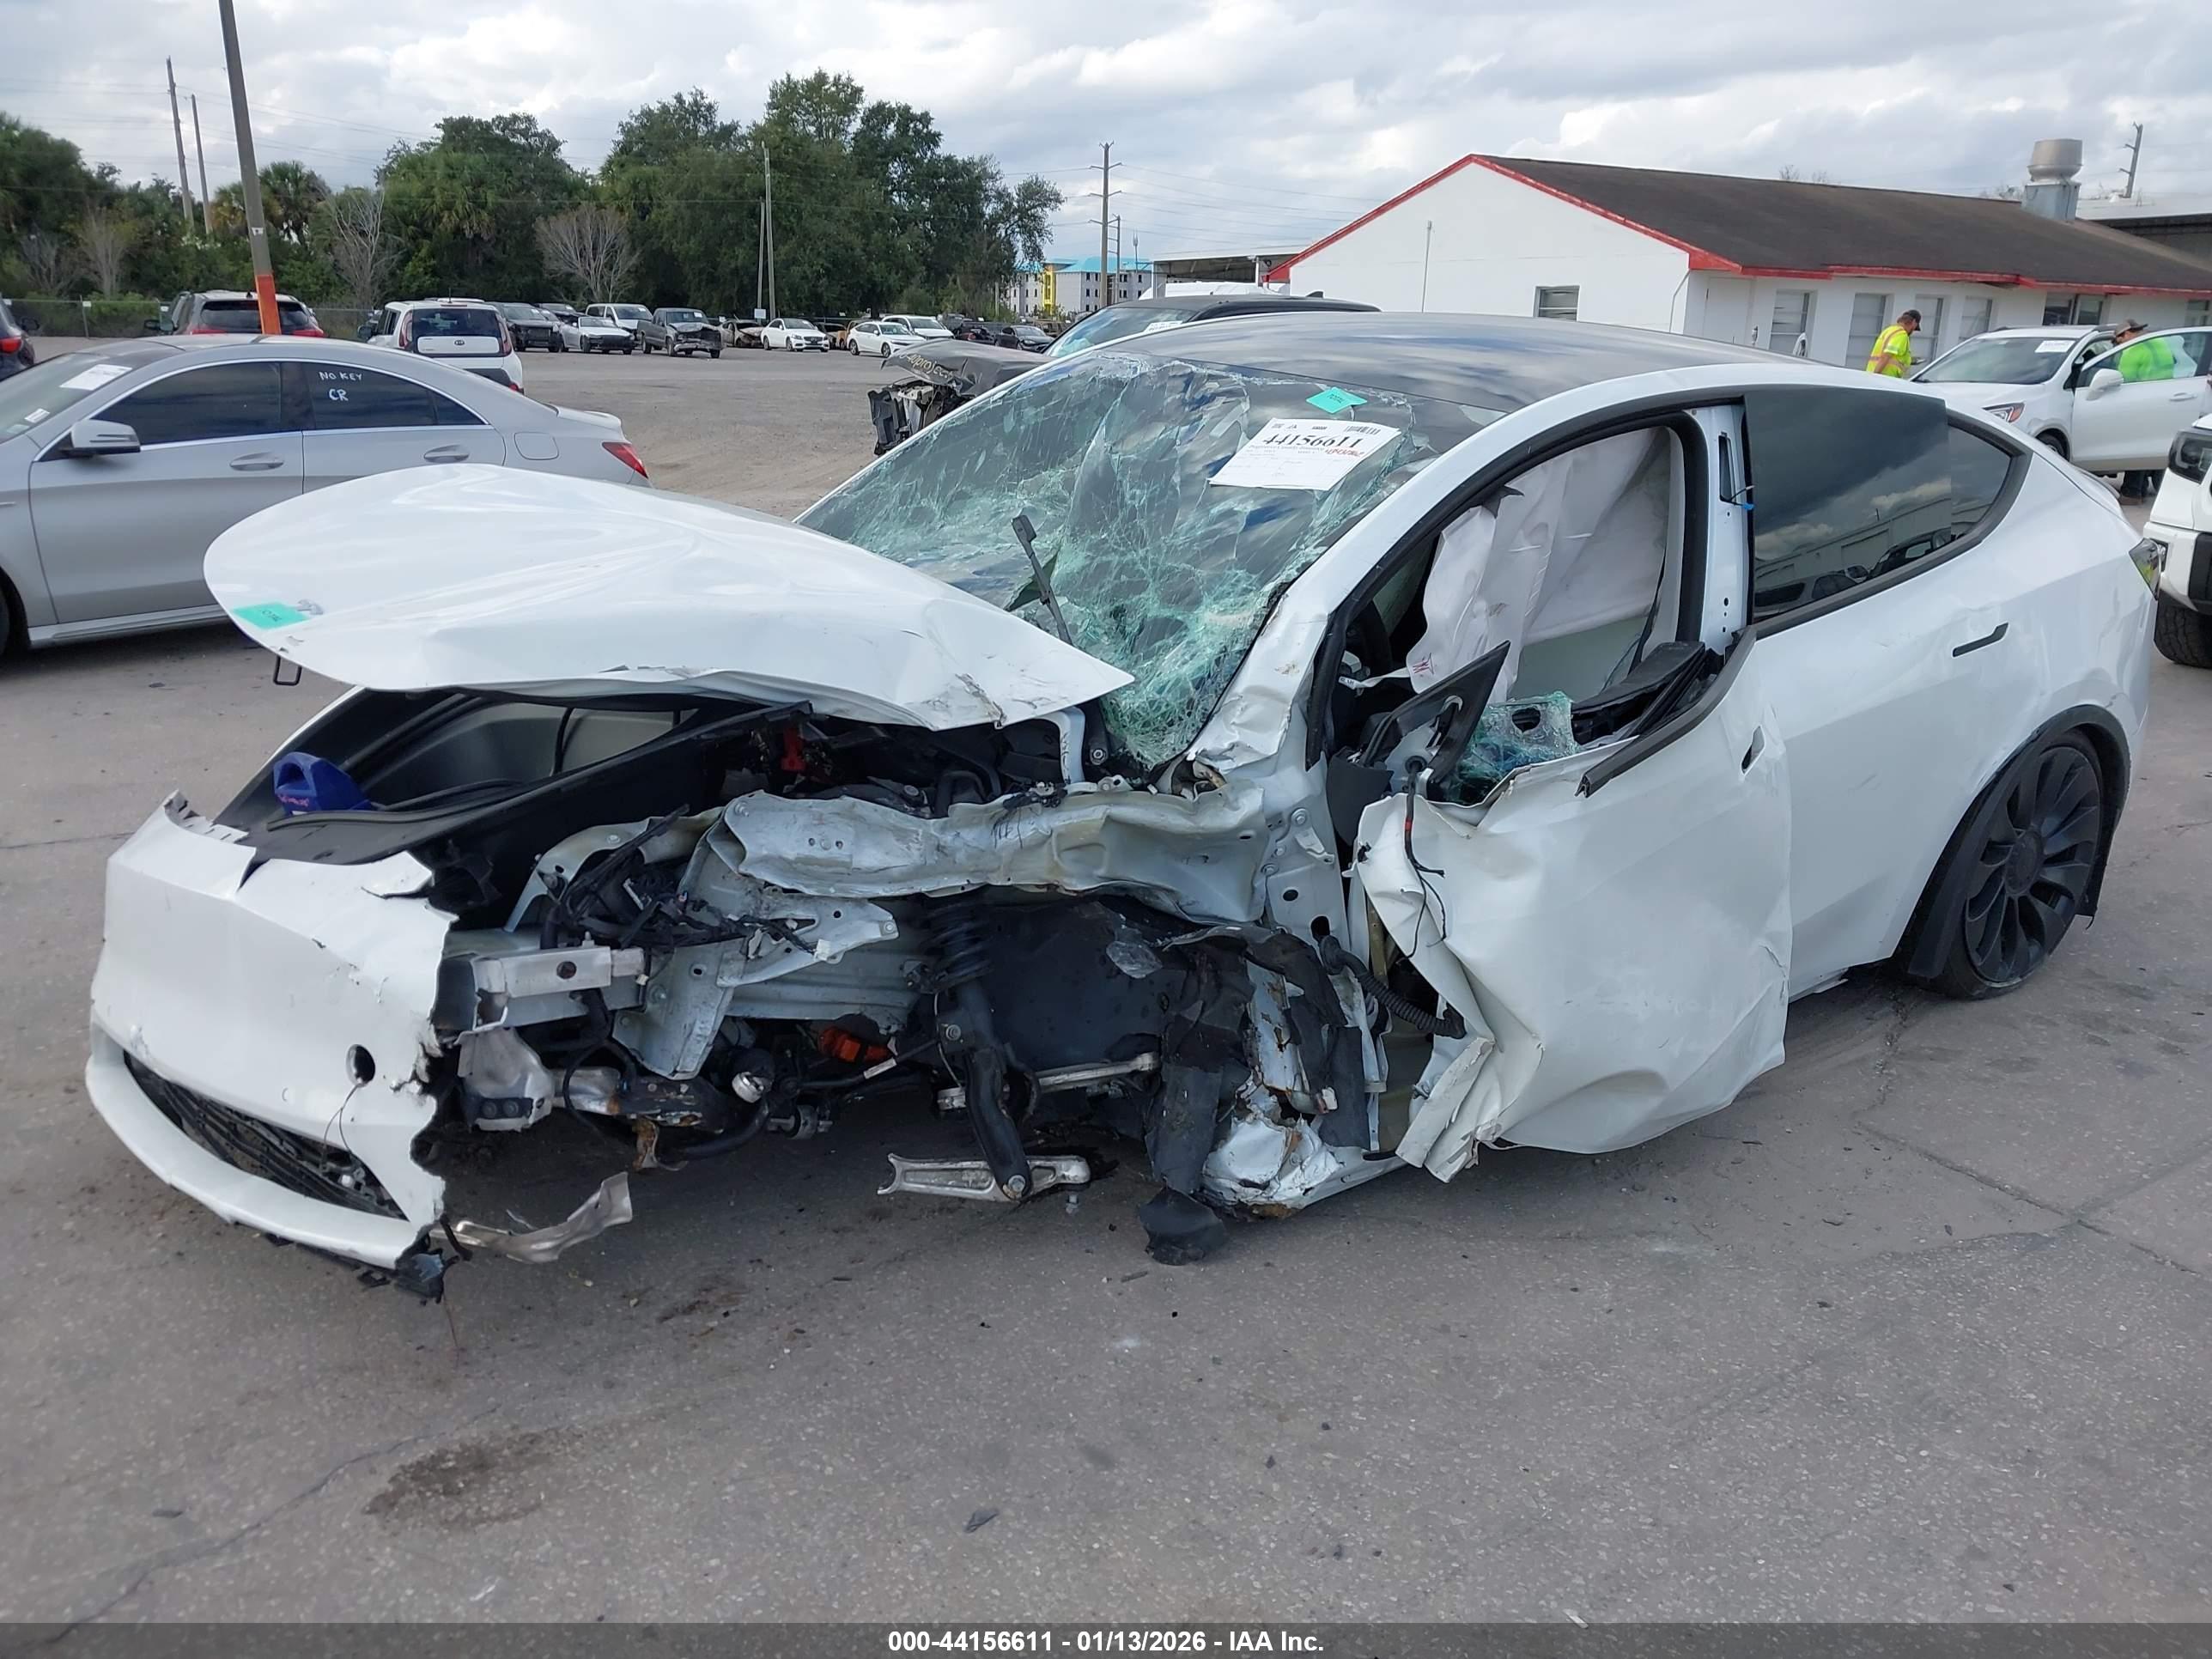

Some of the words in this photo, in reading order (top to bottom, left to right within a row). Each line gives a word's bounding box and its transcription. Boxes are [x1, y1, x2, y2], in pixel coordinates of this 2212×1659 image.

[319, 371, 337, 380] NO
[338, 371, 362, 381] KEY
[329, 388, 349, 401] CR
